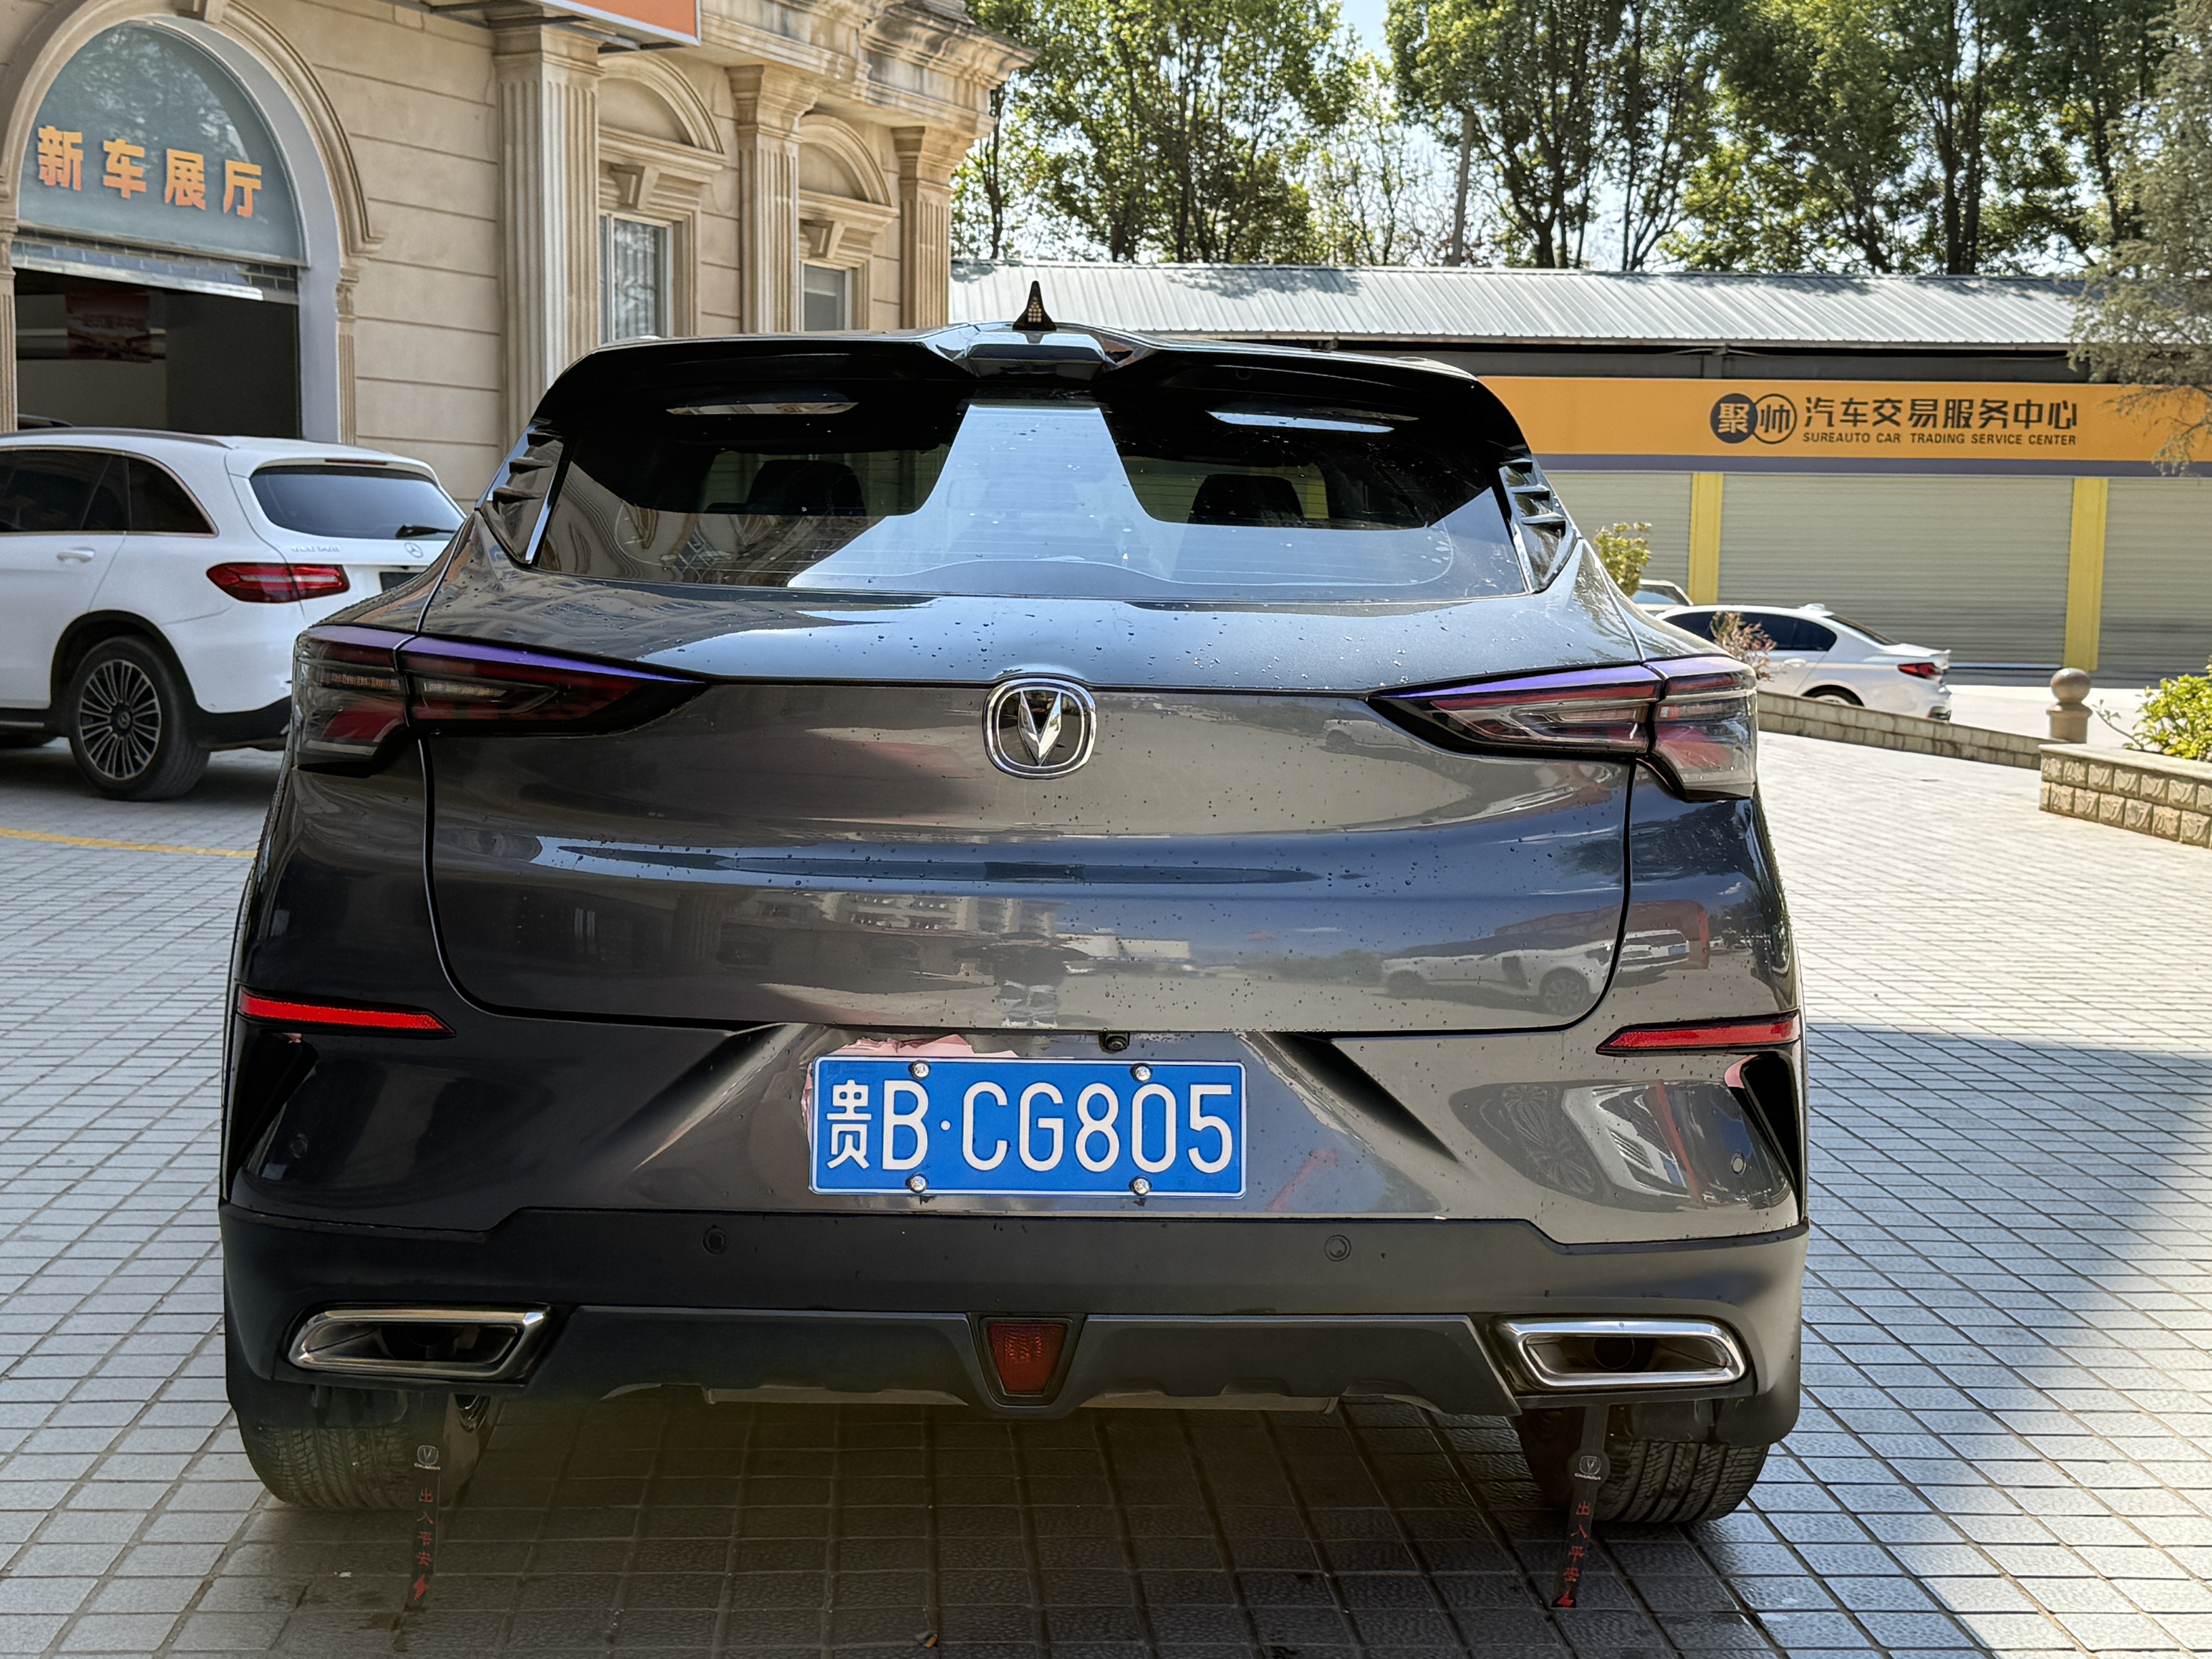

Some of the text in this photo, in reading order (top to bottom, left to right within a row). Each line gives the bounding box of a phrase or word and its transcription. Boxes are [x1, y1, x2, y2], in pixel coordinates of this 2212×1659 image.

[38, 125, 262, 218] 新车展厅
[1804, 397, 2077, 429] 汽车交易服务中心
[1803, 432, 2076, 445] SUREAUTO CAR TRADING SERVICE CENTER
